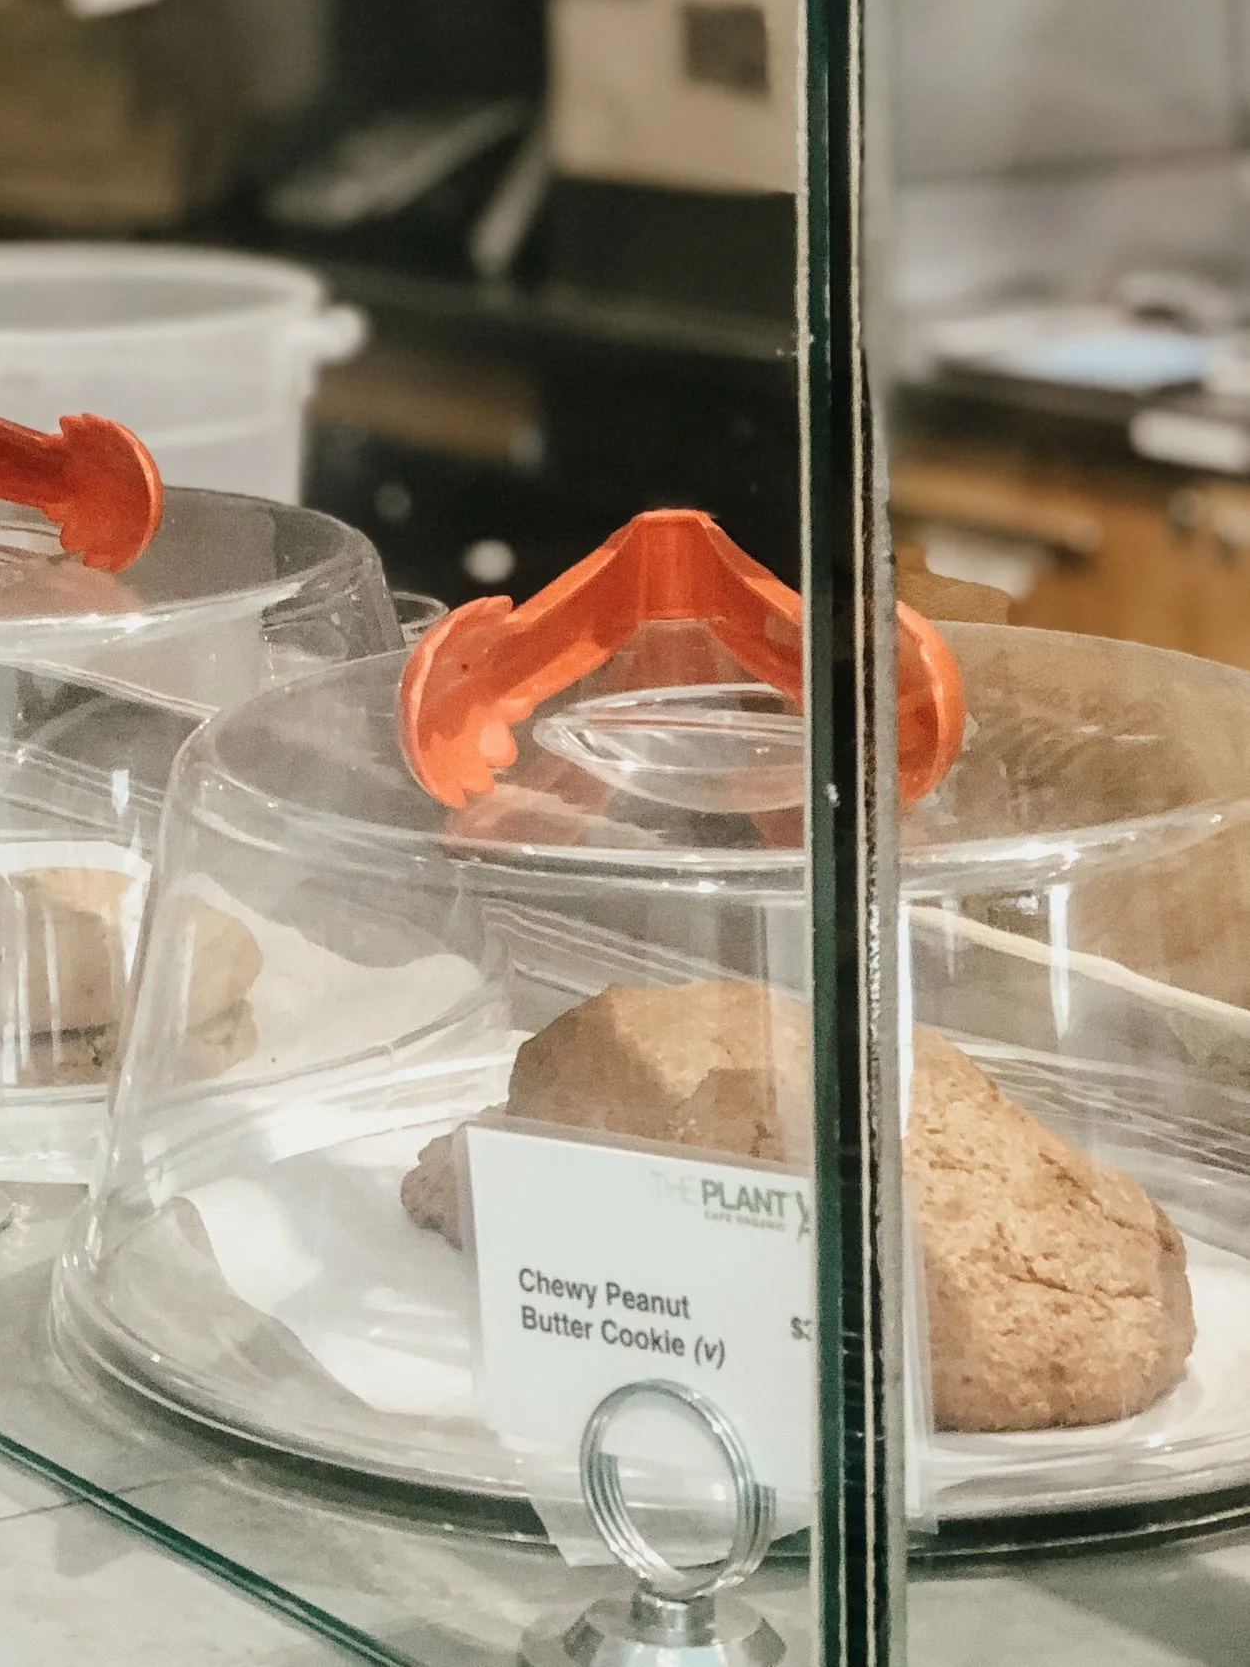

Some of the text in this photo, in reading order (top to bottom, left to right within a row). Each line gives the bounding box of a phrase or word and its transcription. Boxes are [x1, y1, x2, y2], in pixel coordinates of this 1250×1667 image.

[702, 1178, 790, 1217] PLANT
[519, 1268, 690, 1320] Chewy Peanut
[521, 1304, 726, 1370] Butter Cookie (v)
